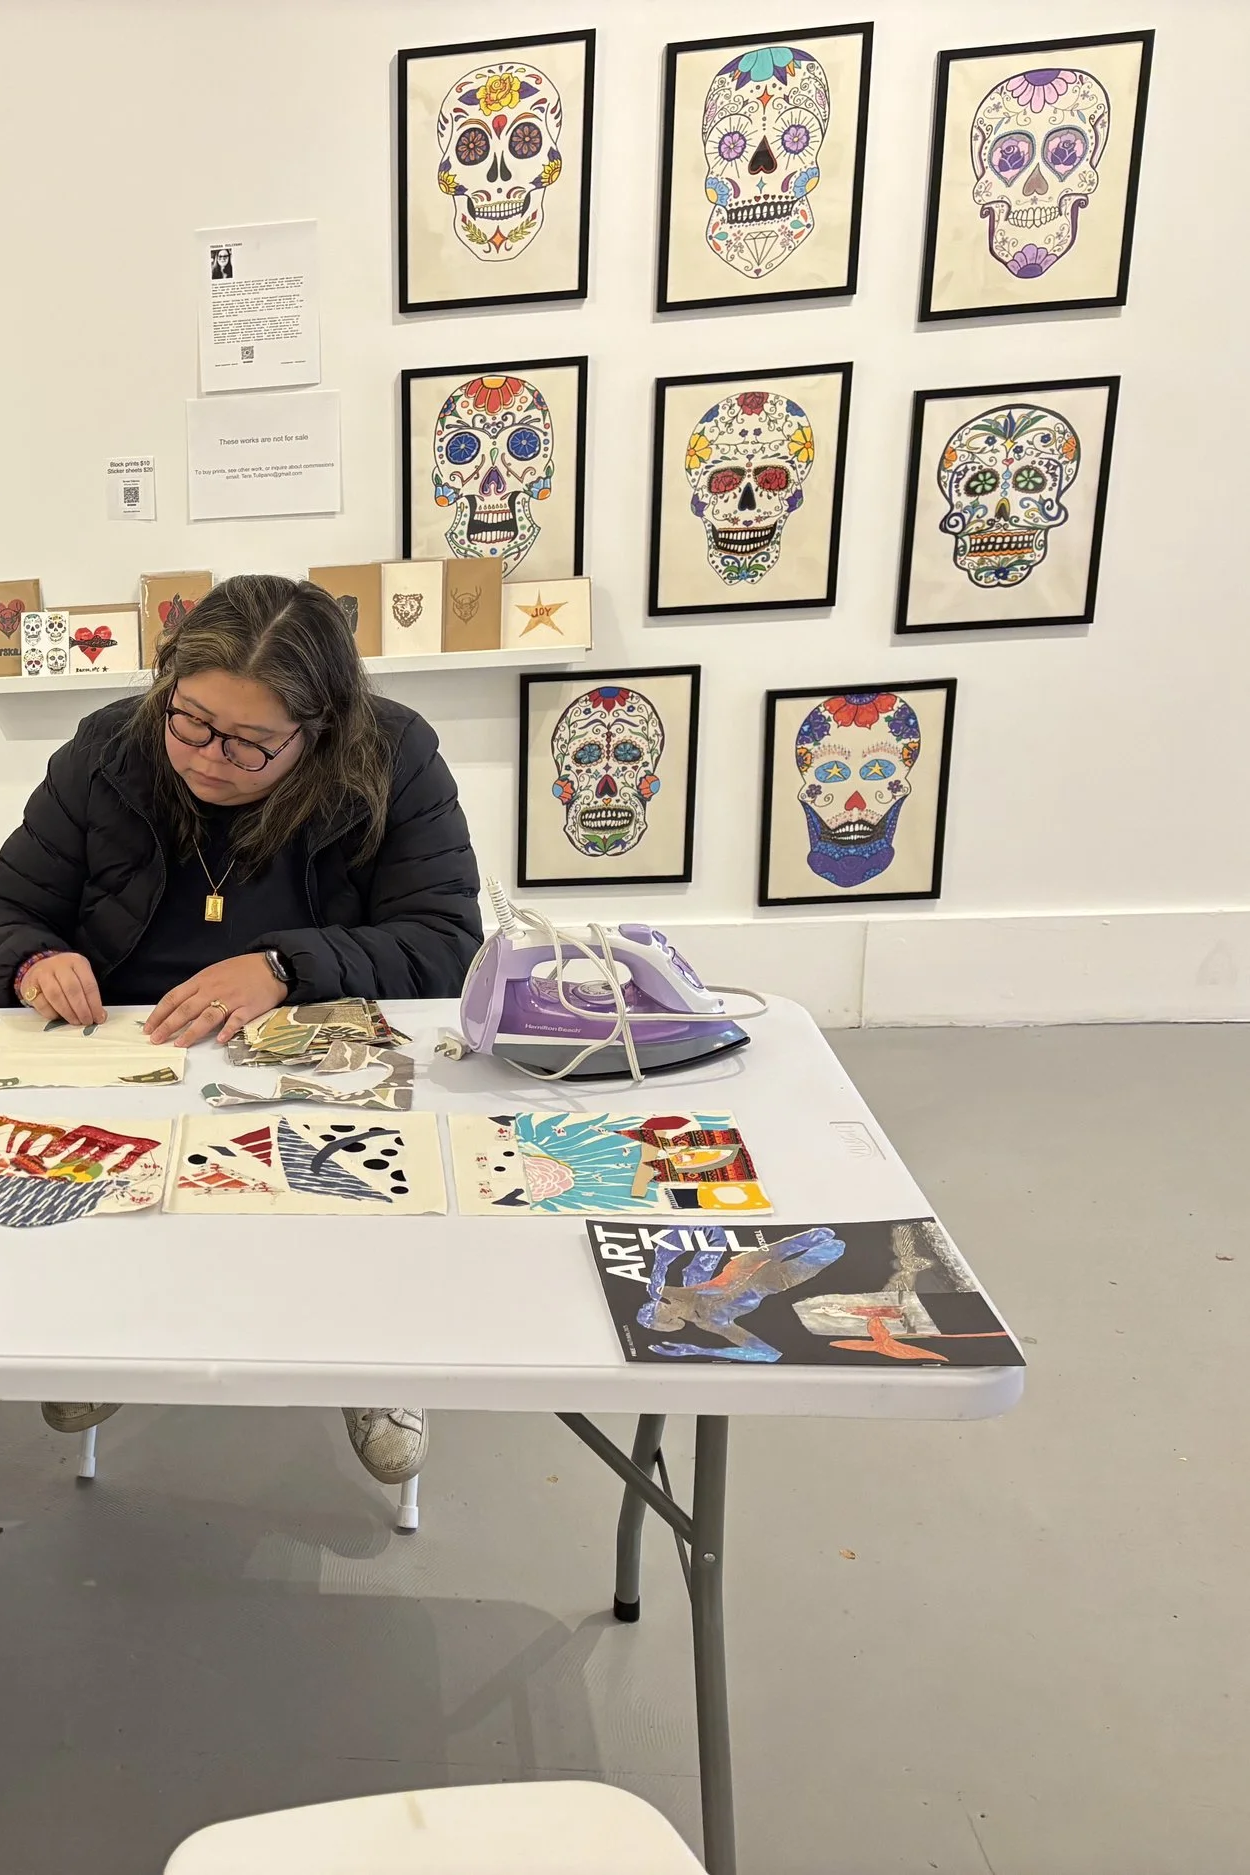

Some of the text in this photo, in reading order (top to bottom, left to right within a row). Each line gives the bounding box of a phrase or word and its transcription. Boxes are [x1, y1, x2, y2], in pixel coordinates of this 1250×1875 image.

[219, 438, 239, 446] These
[294, 433, 309, 441] sale
[202, 468, 212, 476] buy
[531, 607, 552, 618] JOY
[525, 1023, 557, 1031] Hamilton
[638, 1227, 759, 1252] KILL
[593, 1224, 652, 1285] ART
